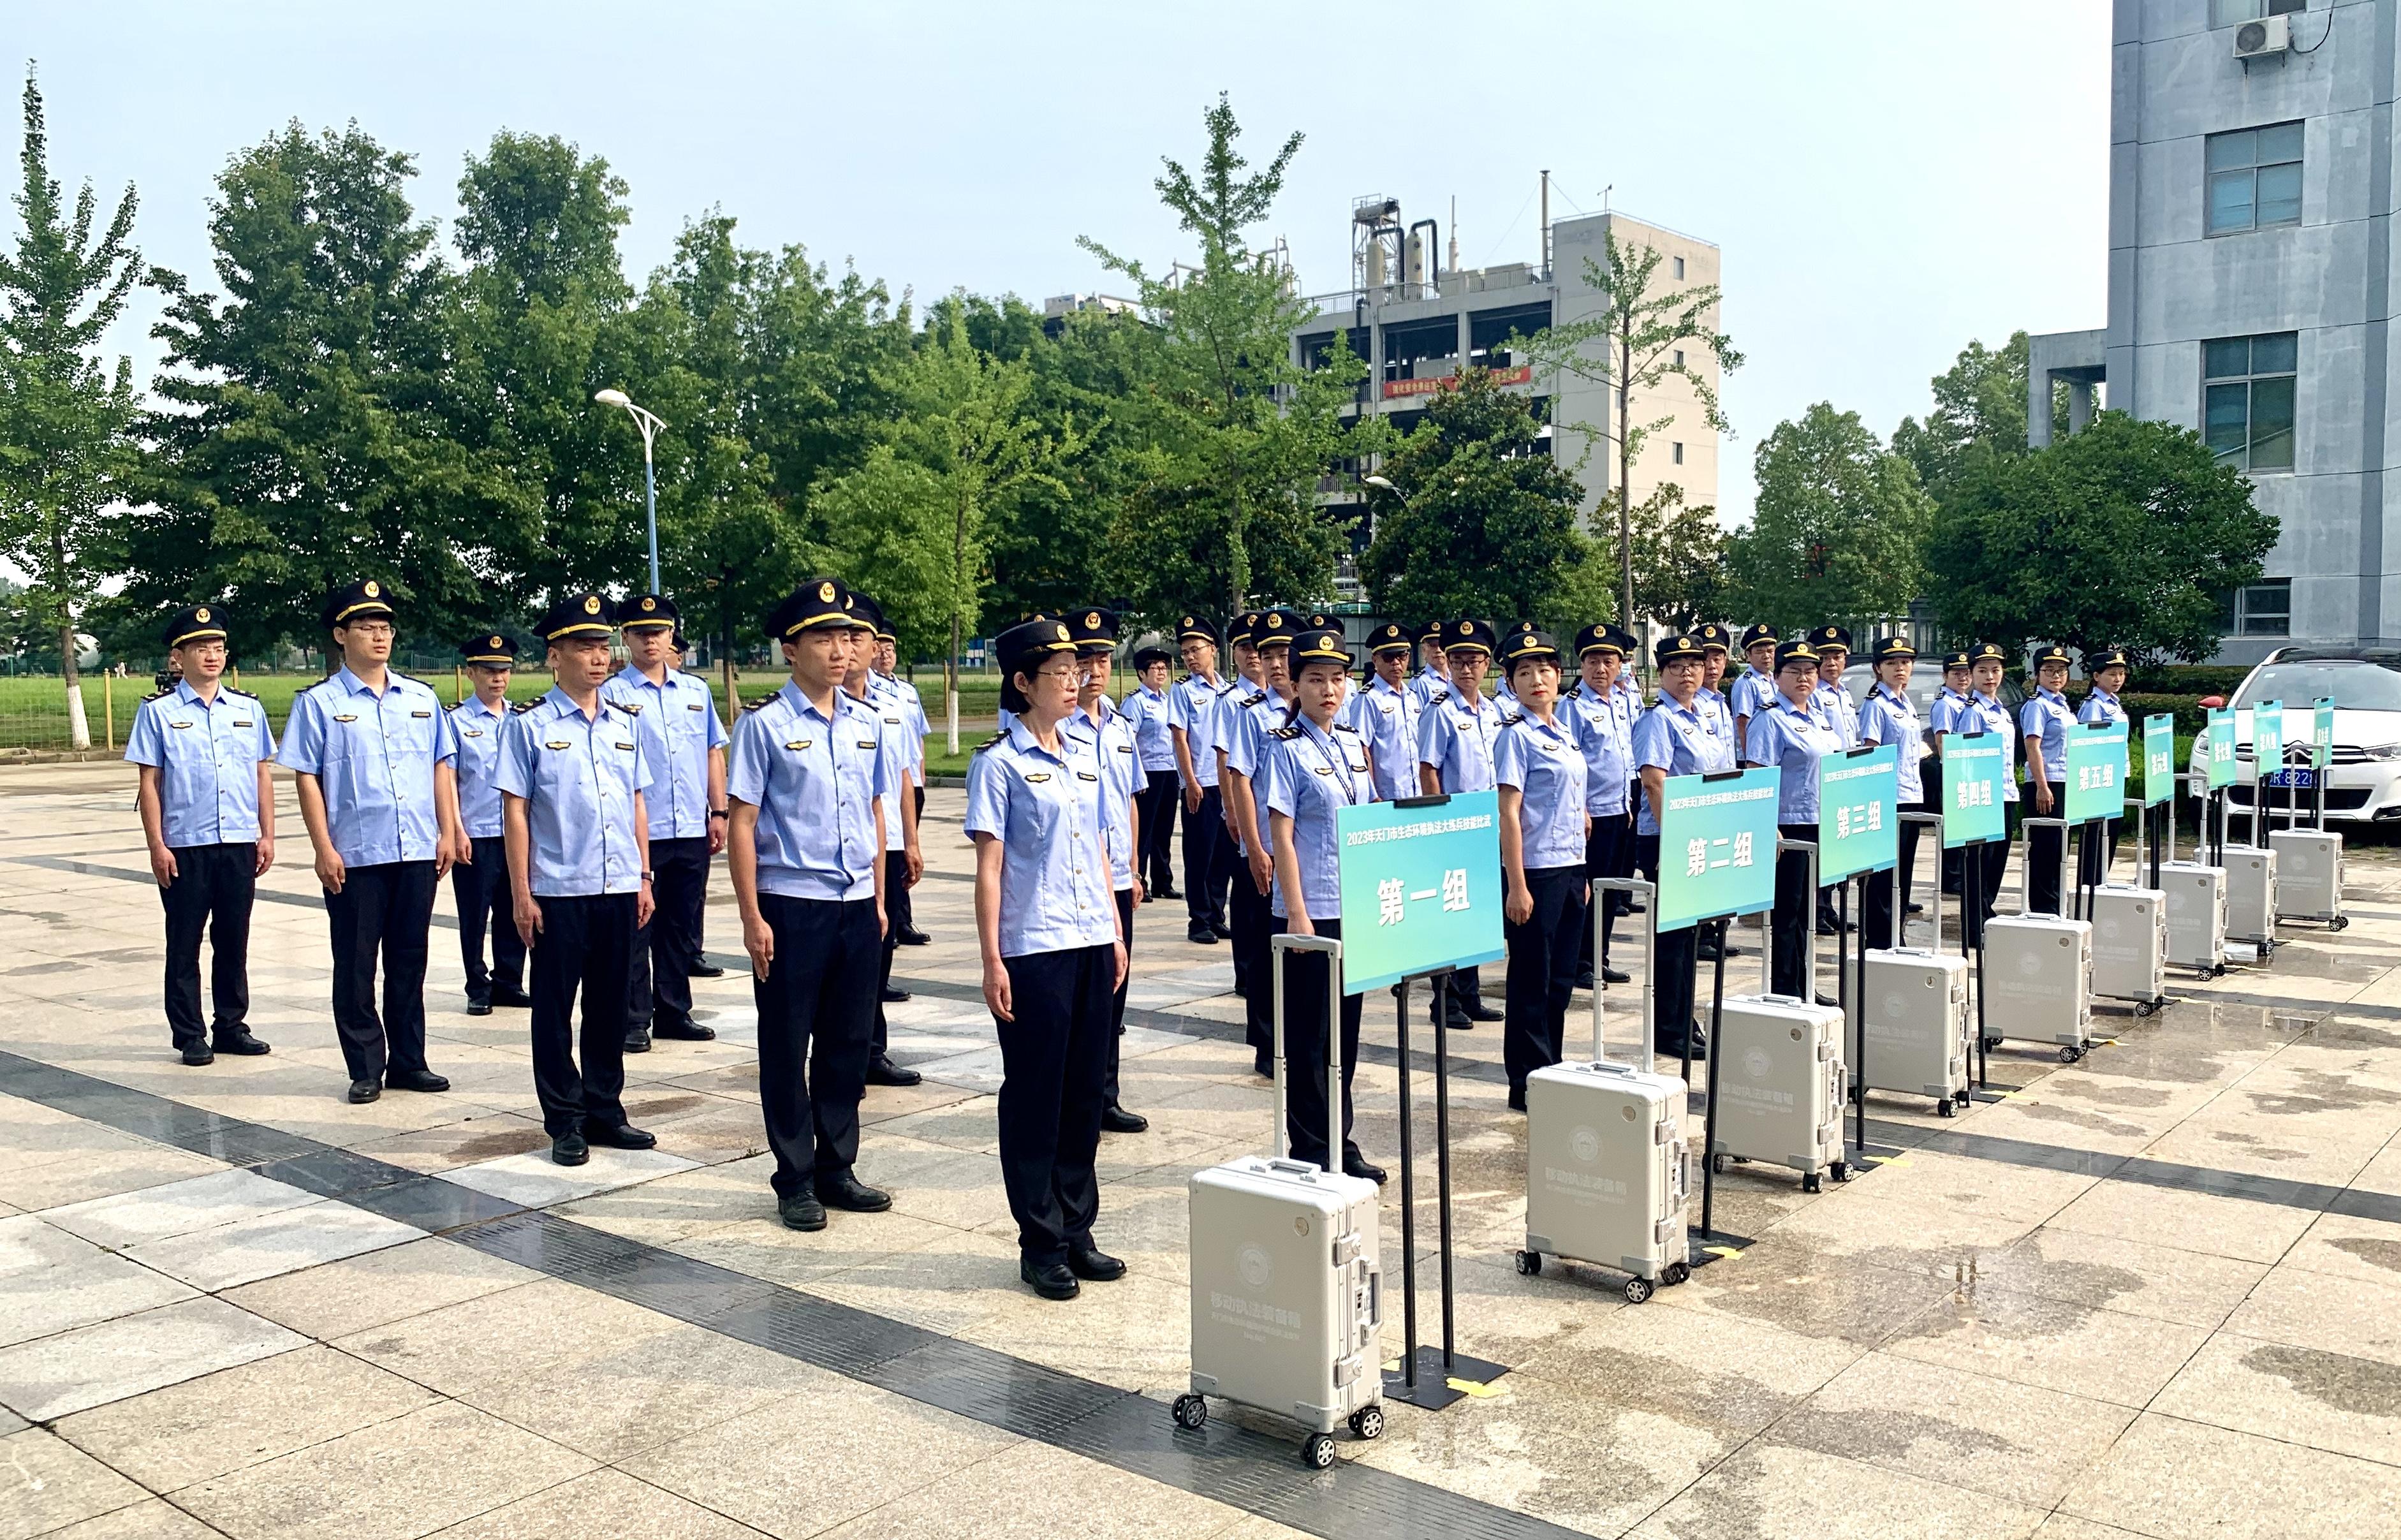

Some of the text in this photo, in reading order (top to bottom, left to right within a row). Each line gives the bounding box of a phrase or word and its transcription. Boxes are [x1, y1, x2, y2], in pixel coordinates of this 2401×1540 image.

[1957, 779, 1992, 810] 第四组
[2078, 763, 2114, 791] 第五组
[1837, 800, 1882, 840] 第三组
[1686, 832, 1753, 877] 第二组
[1377, 868, 1471, 927] 第一组
